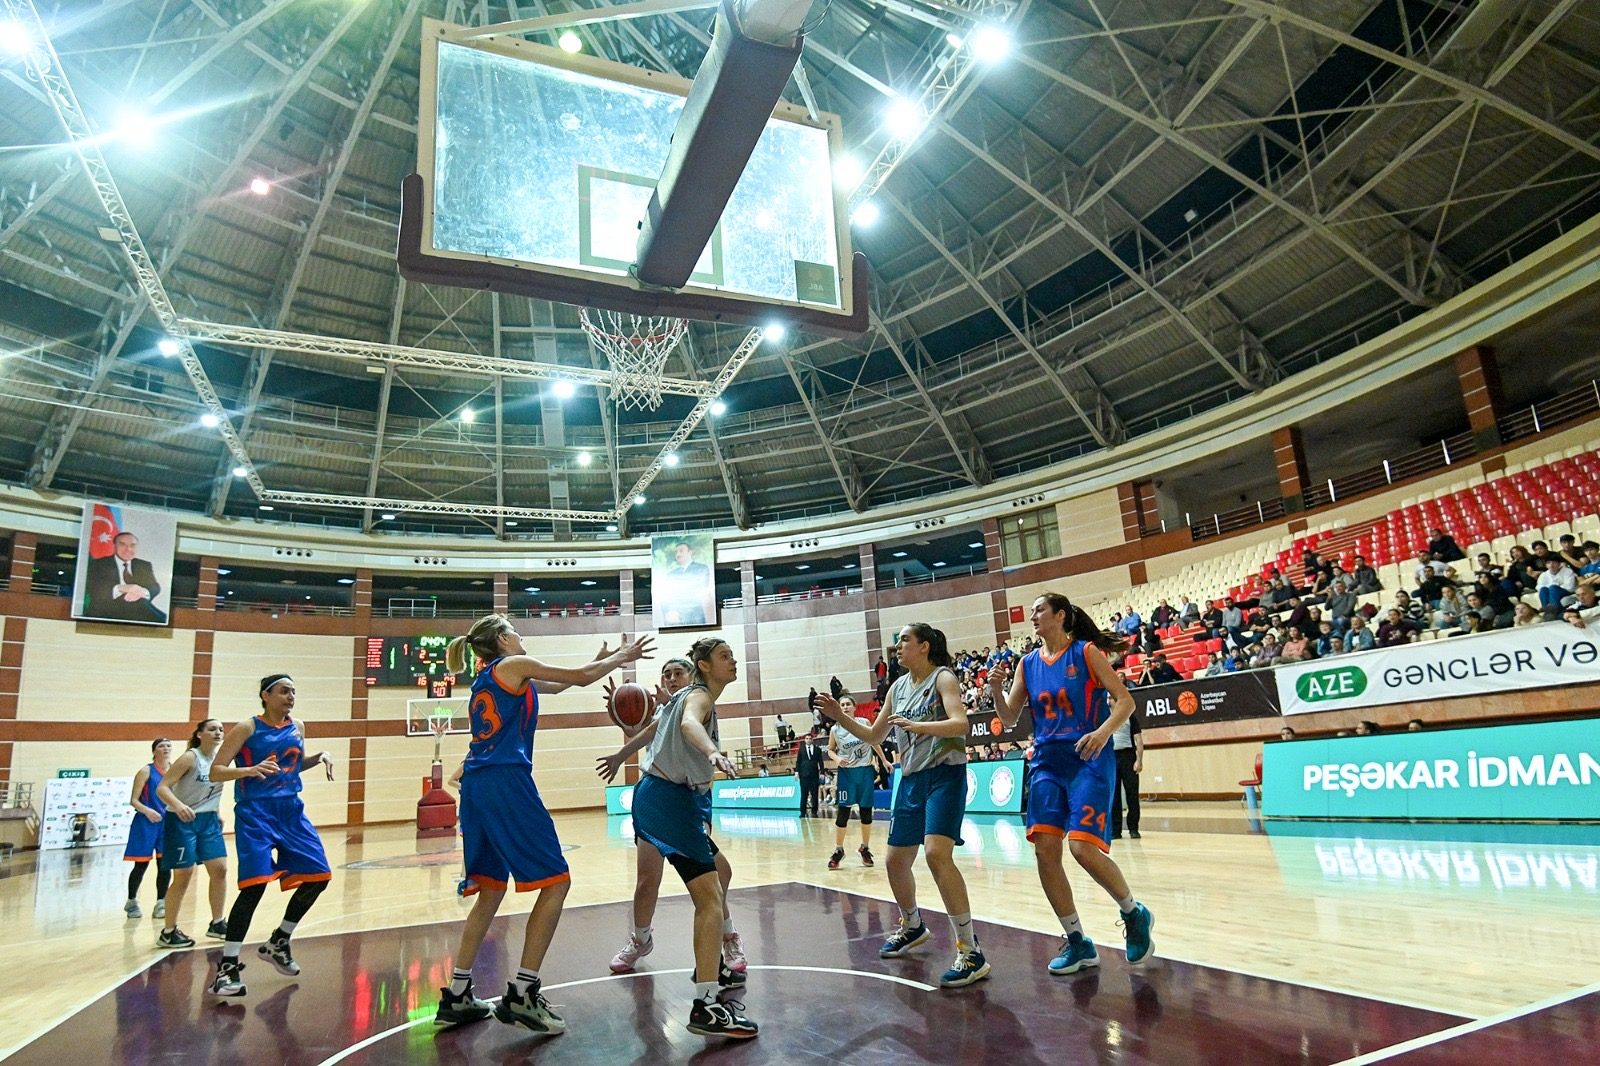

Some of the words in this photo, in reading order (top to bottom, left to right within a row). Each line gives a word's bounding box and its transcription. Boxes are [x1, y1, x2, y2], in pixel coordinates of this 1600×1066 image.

[1383, 649, 1536, 688] GƏNCLƏR
[1544, 641, 1598, 667] VƏ
[433, 687, 446, 698] 40
[1307, 671, 1355, 698] AZE
[1038, 687, 1073, 720] 24
[1145, 698, 1177, 717] ABL
[971, 722, 990, 737] ABL
[1303, 758, 1461, 798] PEŞƏKAR
[1467, 750, 1600, 788] İDMAN
[838, 790, 848, 801] 10
[1079, 805, 1107, 833] 24
[177, 846, 186, 861] 7
